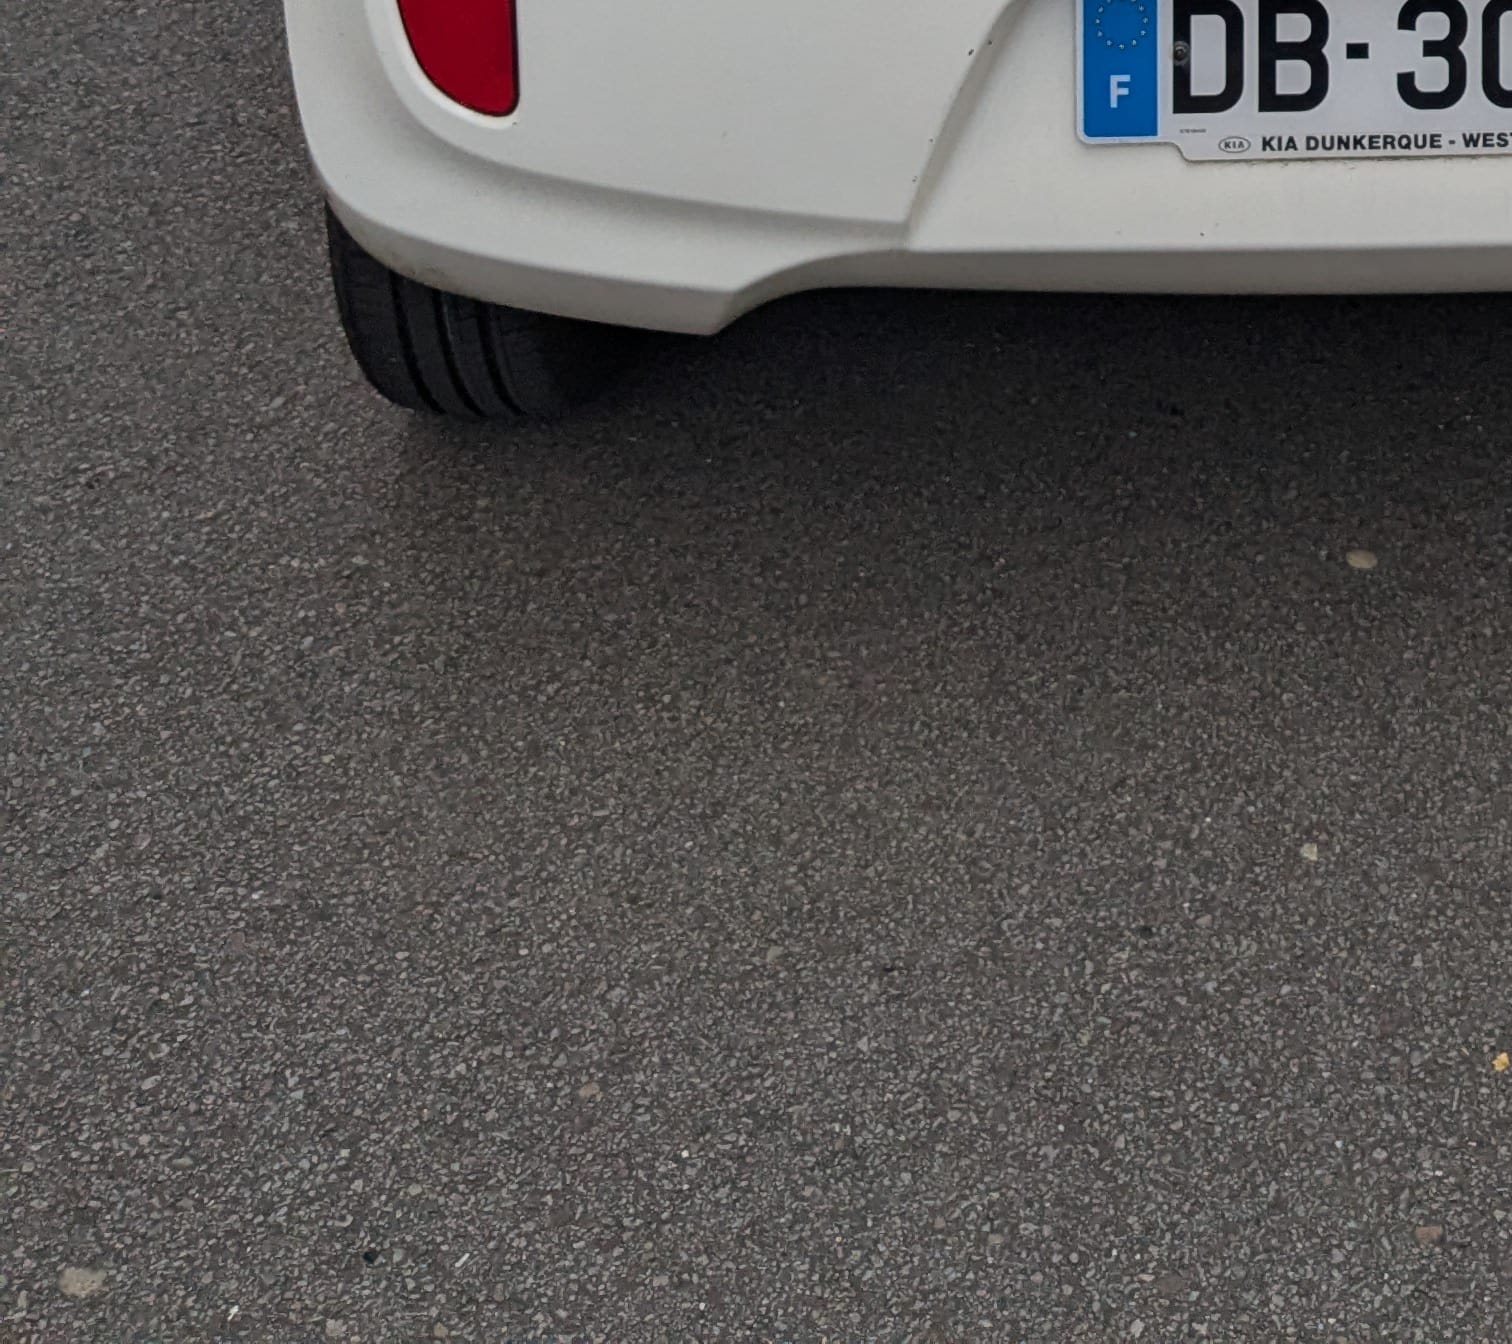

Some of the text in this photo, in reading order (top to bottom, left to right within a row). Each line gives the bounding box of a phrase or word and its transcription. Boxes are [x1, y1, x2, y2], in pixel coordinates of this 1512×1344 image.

[1110, 74, 1131, 108] F
[1262, 136, 1298, 152] KIA
[1305, 133, 1443, 152] DUNKERQUE
